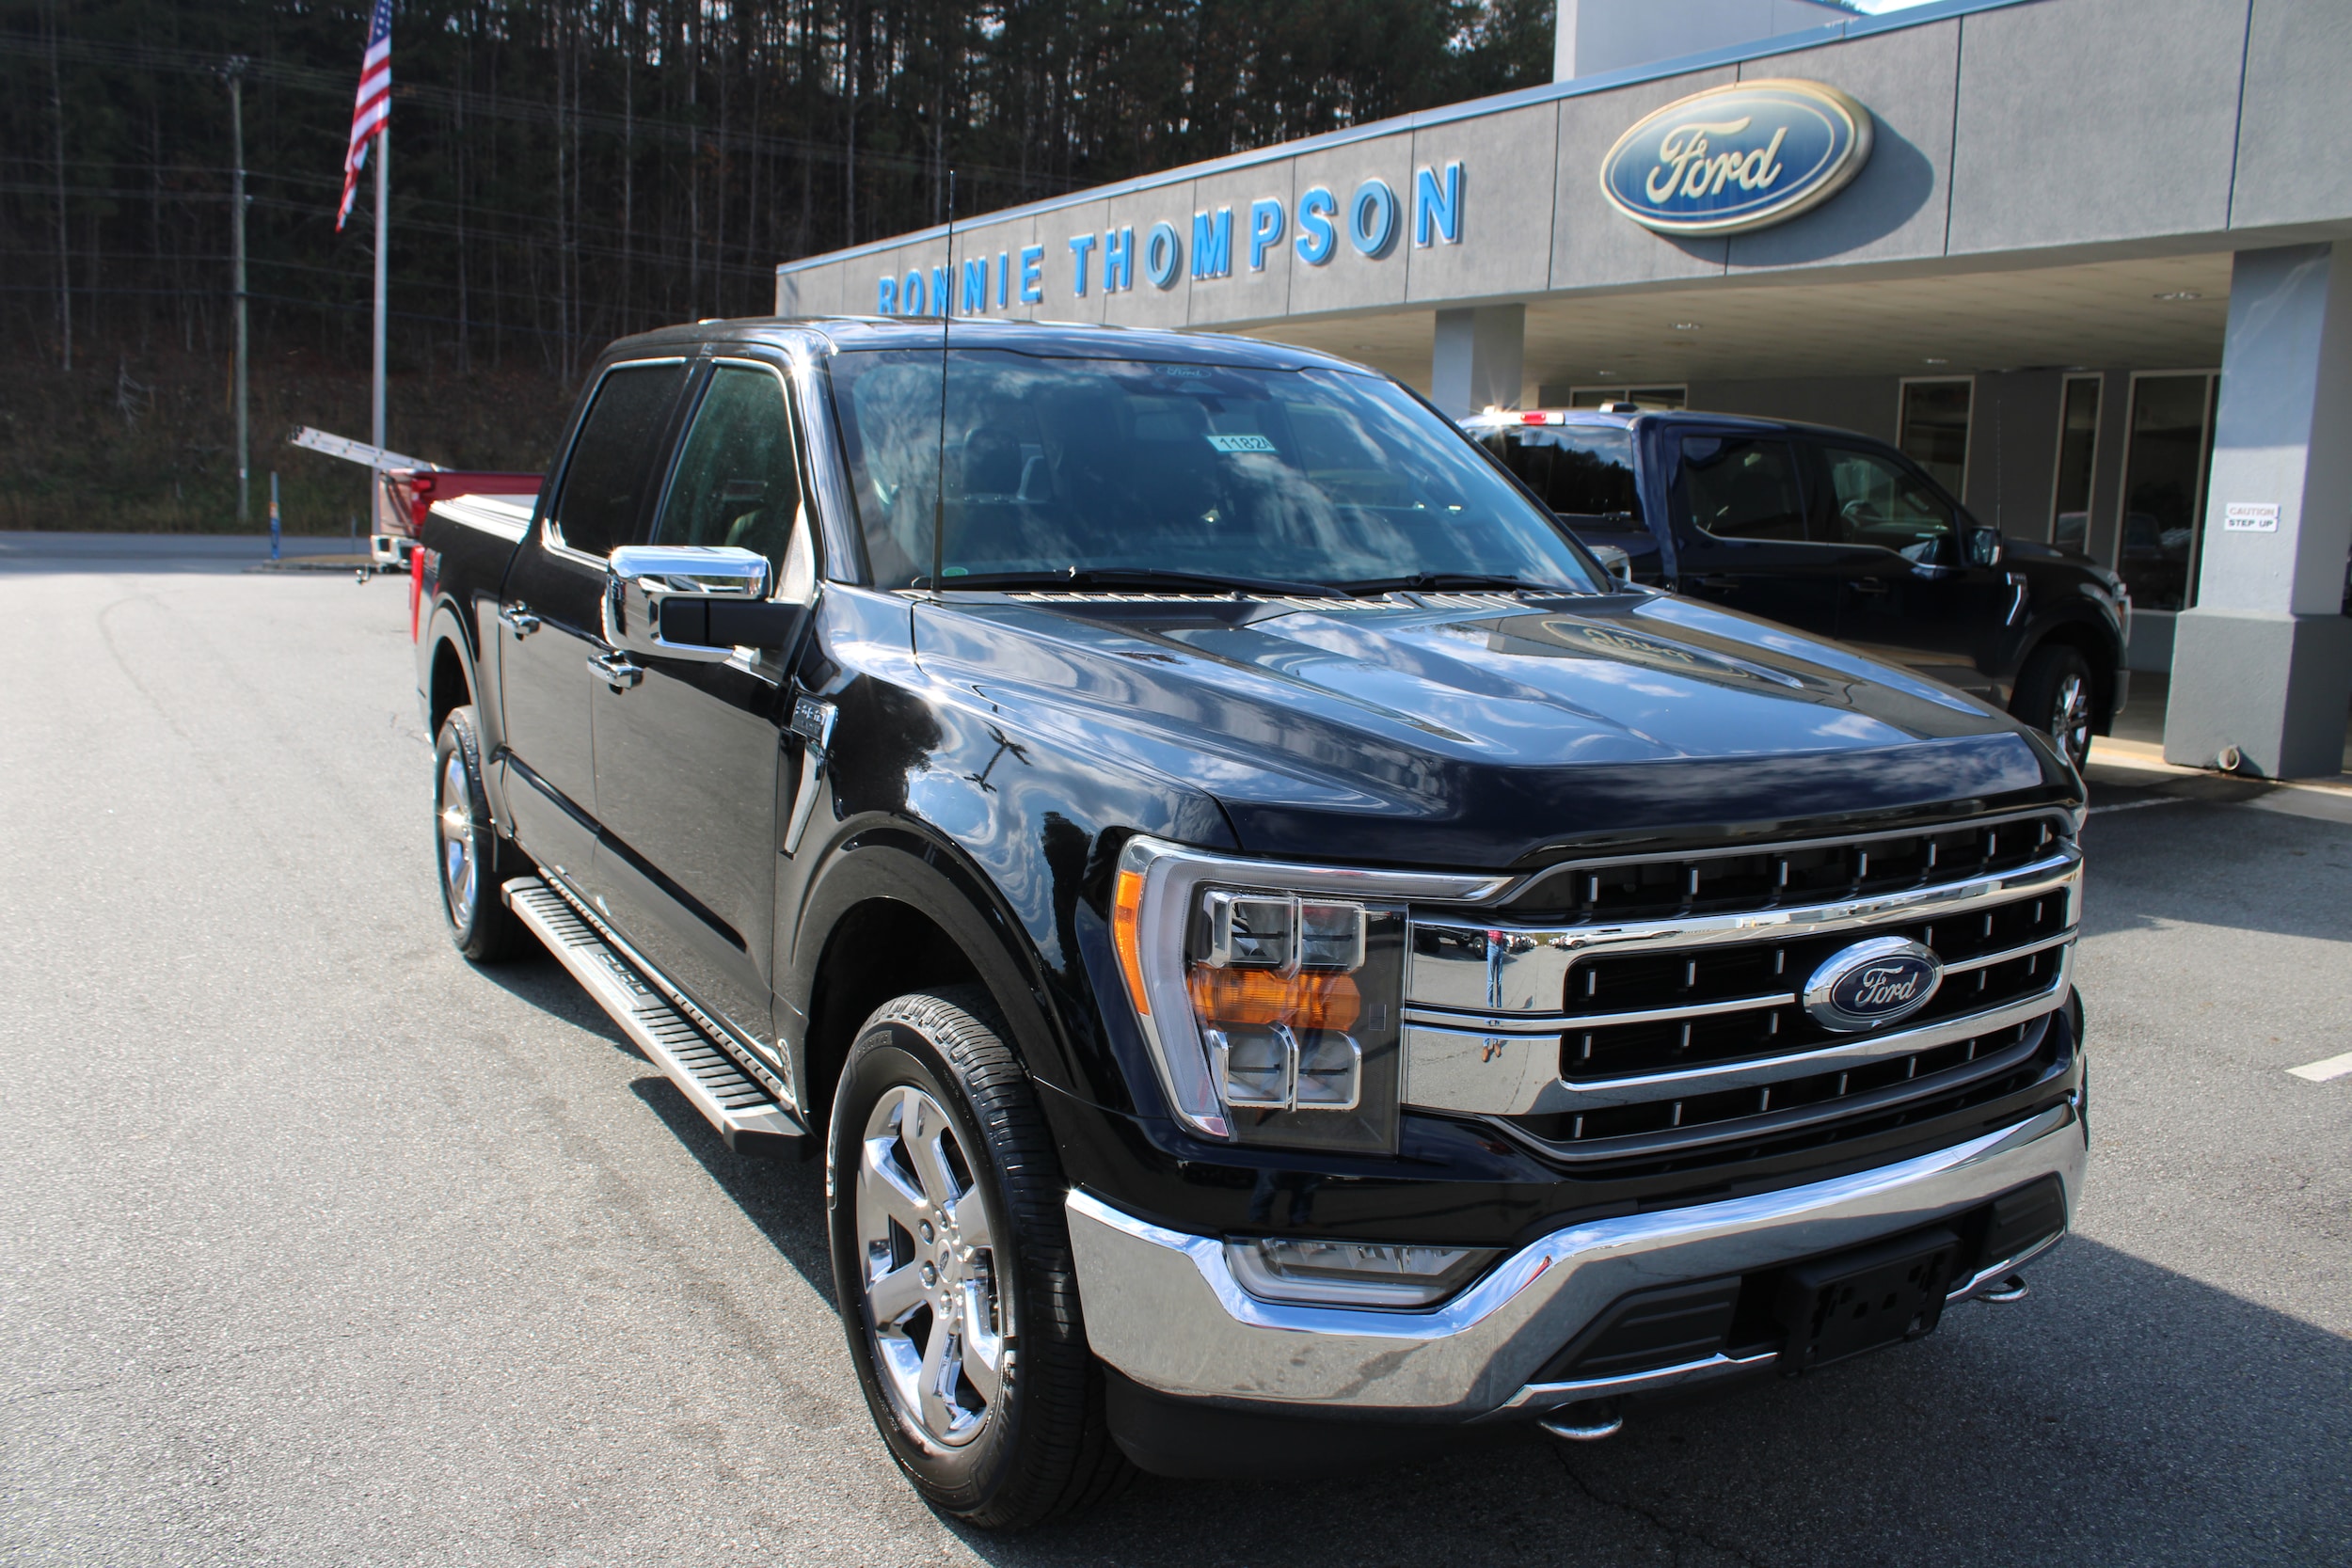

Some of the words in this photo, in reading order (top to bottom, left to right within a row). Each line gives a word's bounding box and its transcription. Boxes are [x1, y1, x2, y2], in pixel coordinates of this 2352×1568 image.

[1646, 116, 1788, 204] Ford
[878, 244, 1044, 318] RONNIE
[1068, 160, 1462, 298] THOMPSON
[2228, 518, 2255, 528] STEP
[2258, 519, 2274, 528] UP
[1854, 965, 1919, 1008] Ford
